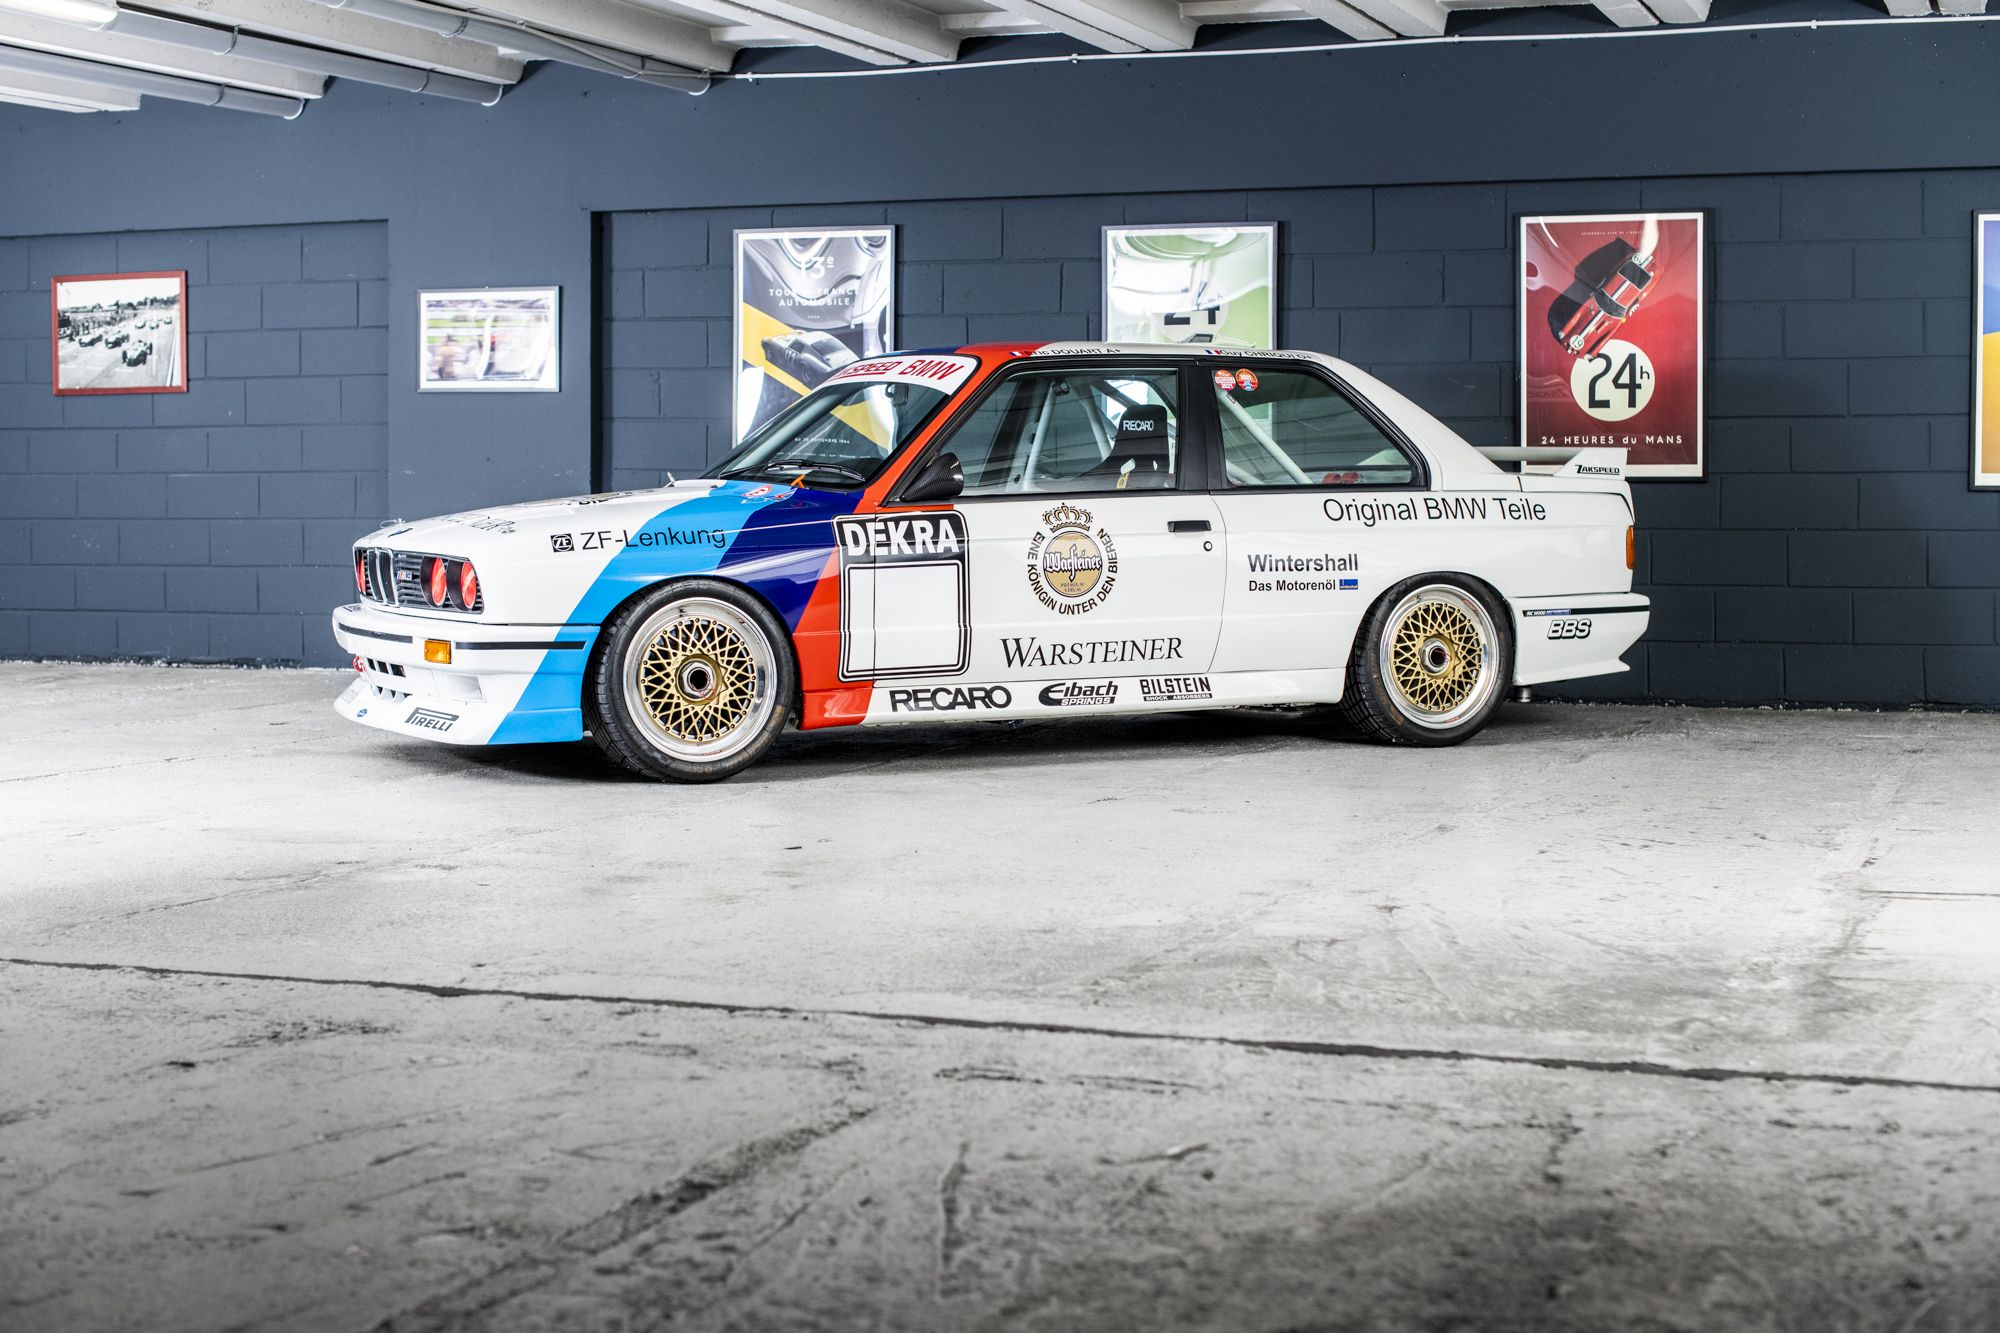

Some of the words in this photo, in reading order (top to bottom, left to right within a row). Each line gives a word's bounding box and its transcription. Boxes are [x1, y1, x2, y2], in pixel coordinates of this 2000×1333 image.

[779, 298, 850, 307] AUTOMOBILE
[898, 360, 965, 380] BMW
[1123, 420, 1154, 431] RECARO
[1541, 436, 1556, 445] 24
[1564, 436, 1614, 445] HEURES
[1623, 436, 1637, 445] du
[1646, 435, 1682, 444] MANS
[1575, 464, 1620, 475] ZAKSPEED
[1323, 498, 1417, 527] Original
[1425, 497, 1487, 520] BMW
[1493, 497, 1546, 521] Teile
[553, 536, 571, 549] ZF
[580, 527, 727, 549] ZF-Lenkung
[845, 518, 960, 557] DEKRA
[1027, 531, 1046, 560] EINE
[1097, 528, 1118, 573] BIEREN
[1247, 554, 1358, 572] Wintershall
[1027, 563, 1058, 610] KÖNIGIN
[1097, 576, 1116, 602] DEN
[1249, 580, 1272, 591] Das
[1276, 579, 1336, 591] Motorenöl
[1058, 598, 1098, 615] UNTER
[1547, 618, 1592, 640] BBS
[1001, 637, 1183, 668] WARSTEINER
[1038, 681, 1119, 706] Eibach
[1139, 677, 1211, 695] BILSTEIN
[889, 685, 1012, 712] RECARO
[1061, 697, 1111, 706] SPRINGS
[405, 706, 460, 732] PIRELLI
